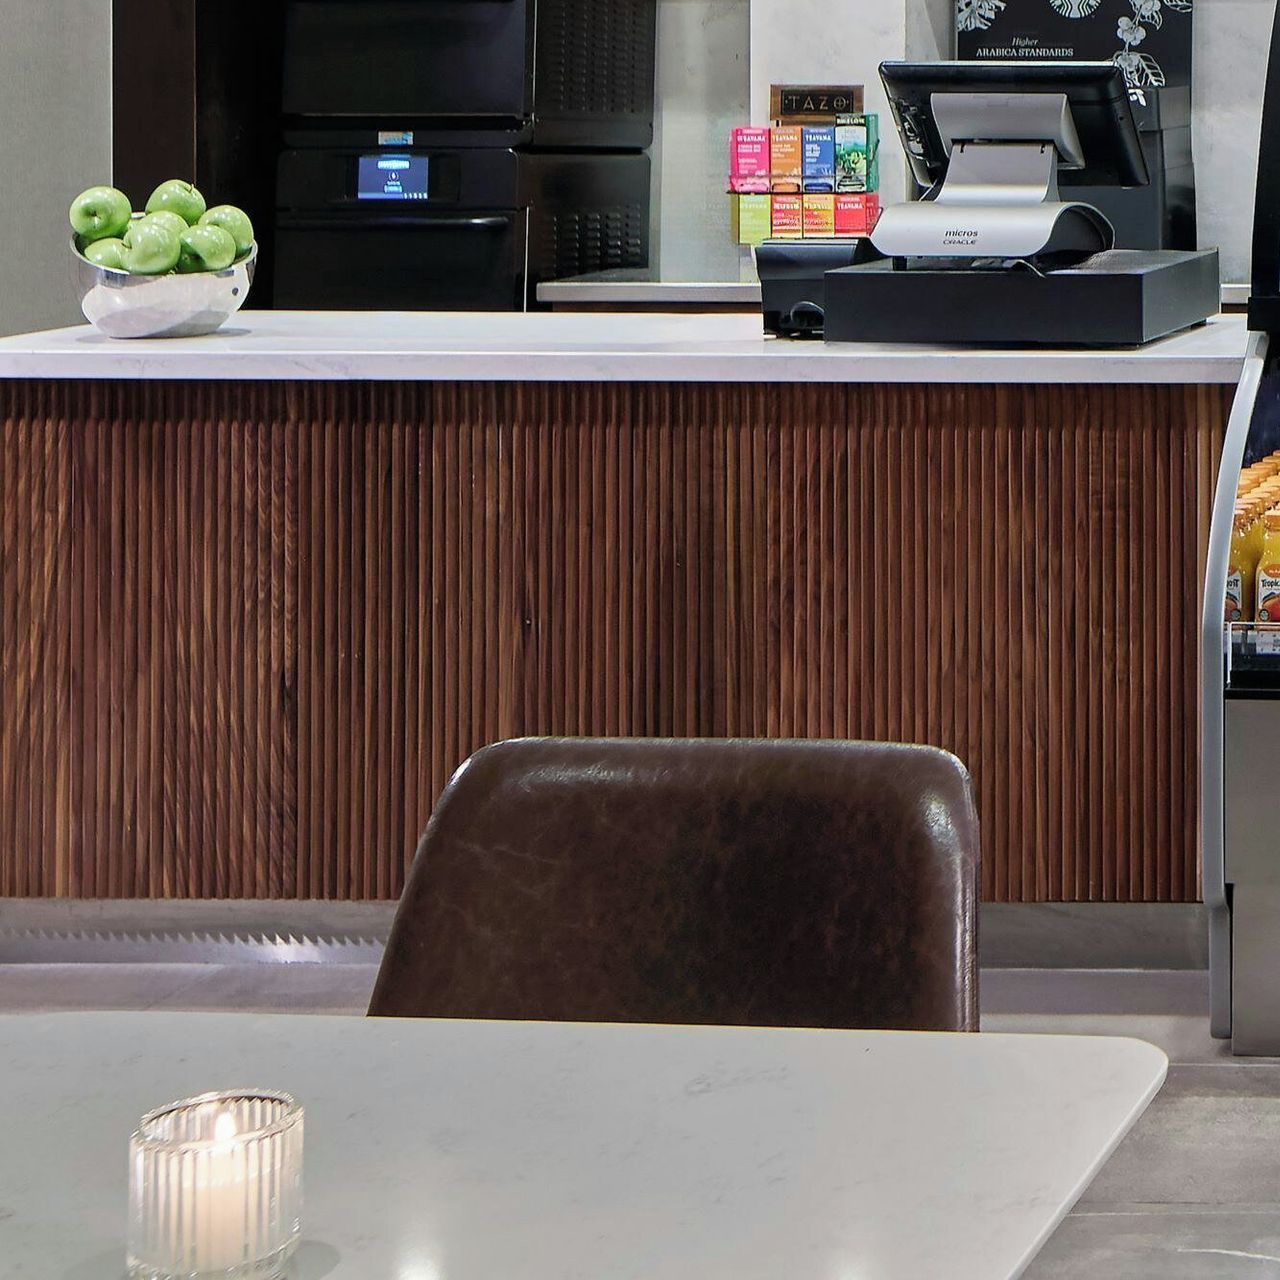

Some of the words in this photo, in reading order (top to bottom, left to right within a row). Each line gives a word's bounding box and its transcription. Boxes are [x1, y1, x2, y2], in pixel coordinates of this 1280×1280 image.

[1012, 37, 1039, 46] Higher
[976, 48, 1017, 57] ARABICA
[1018, 48, 1074, 57] STANDARDS
[788, 96, 846, 110] TAZO
